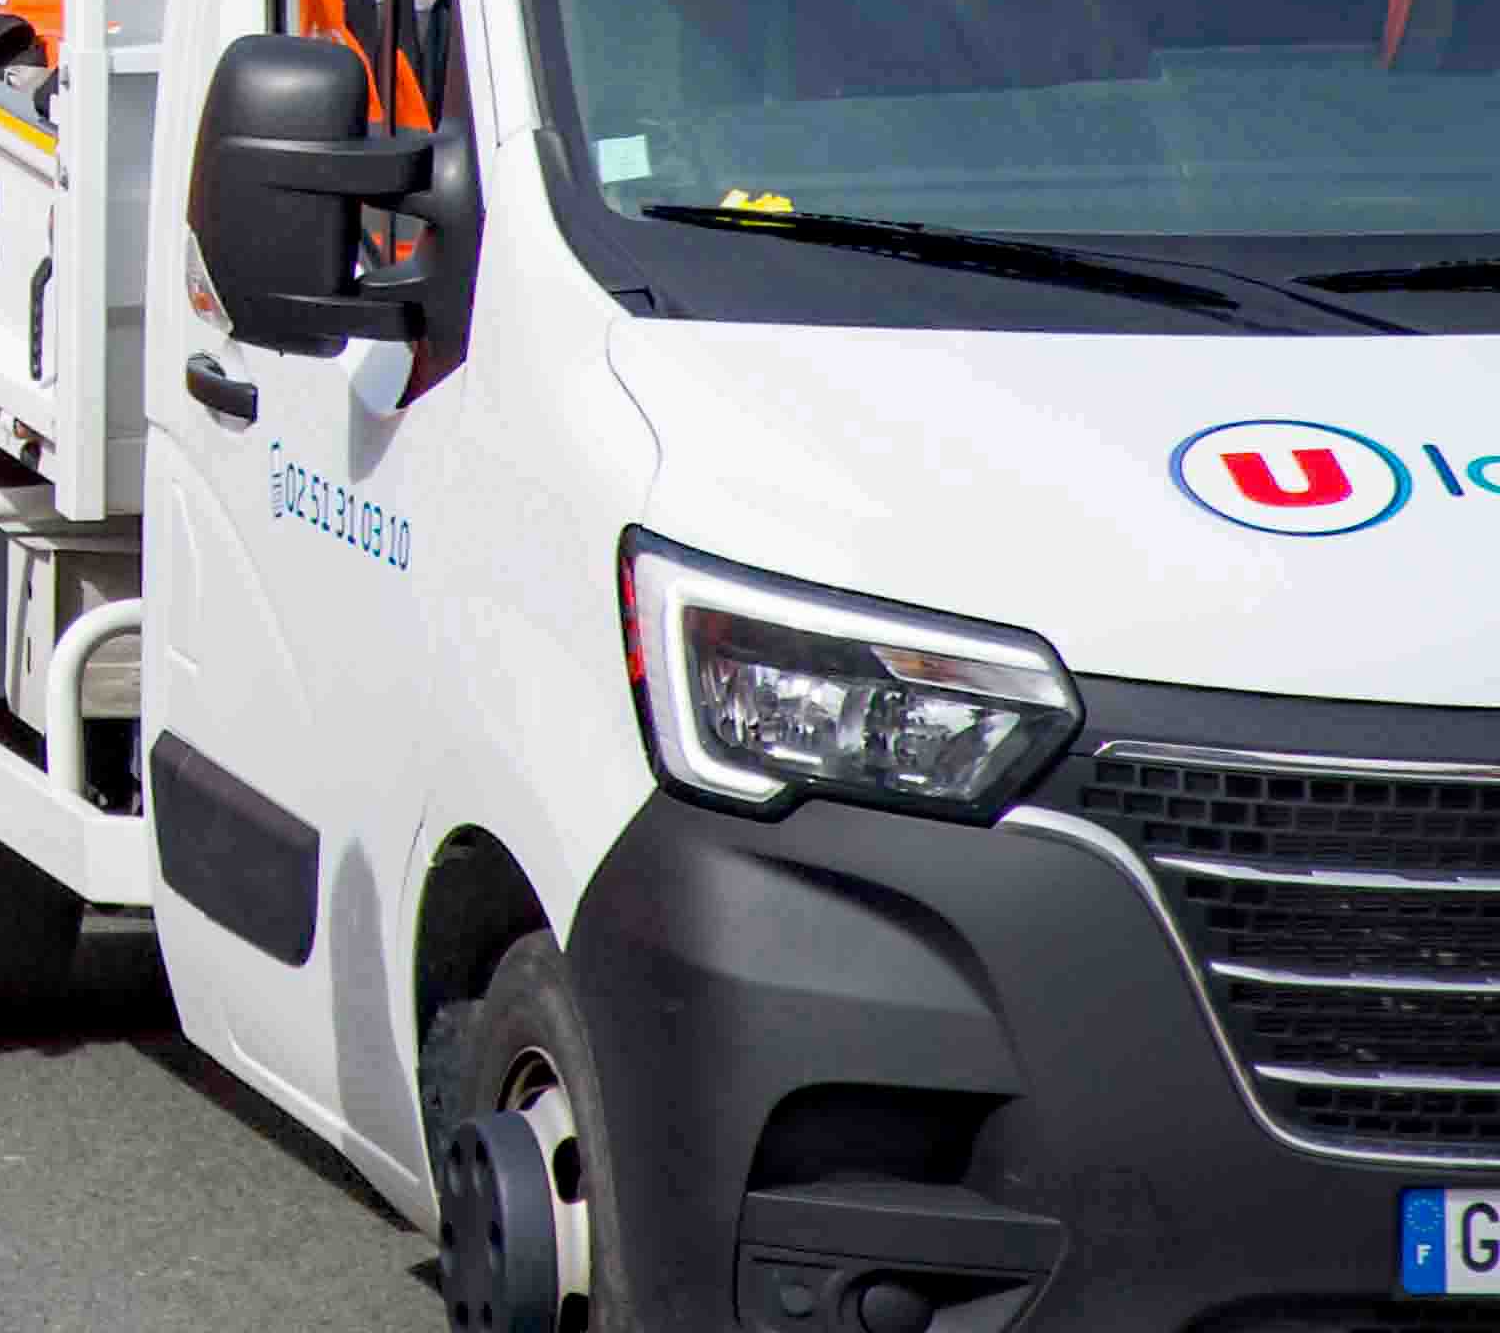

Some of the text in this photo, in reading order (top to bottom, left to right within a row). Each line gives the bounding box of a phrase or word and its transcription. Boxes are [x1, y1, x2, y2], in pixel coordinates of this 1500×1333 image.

[1219, 448, 1353, 508] U
[285, 463, 410, 572] 02 51 31 03 10
[1415, 1244, 1433, 1266] F
